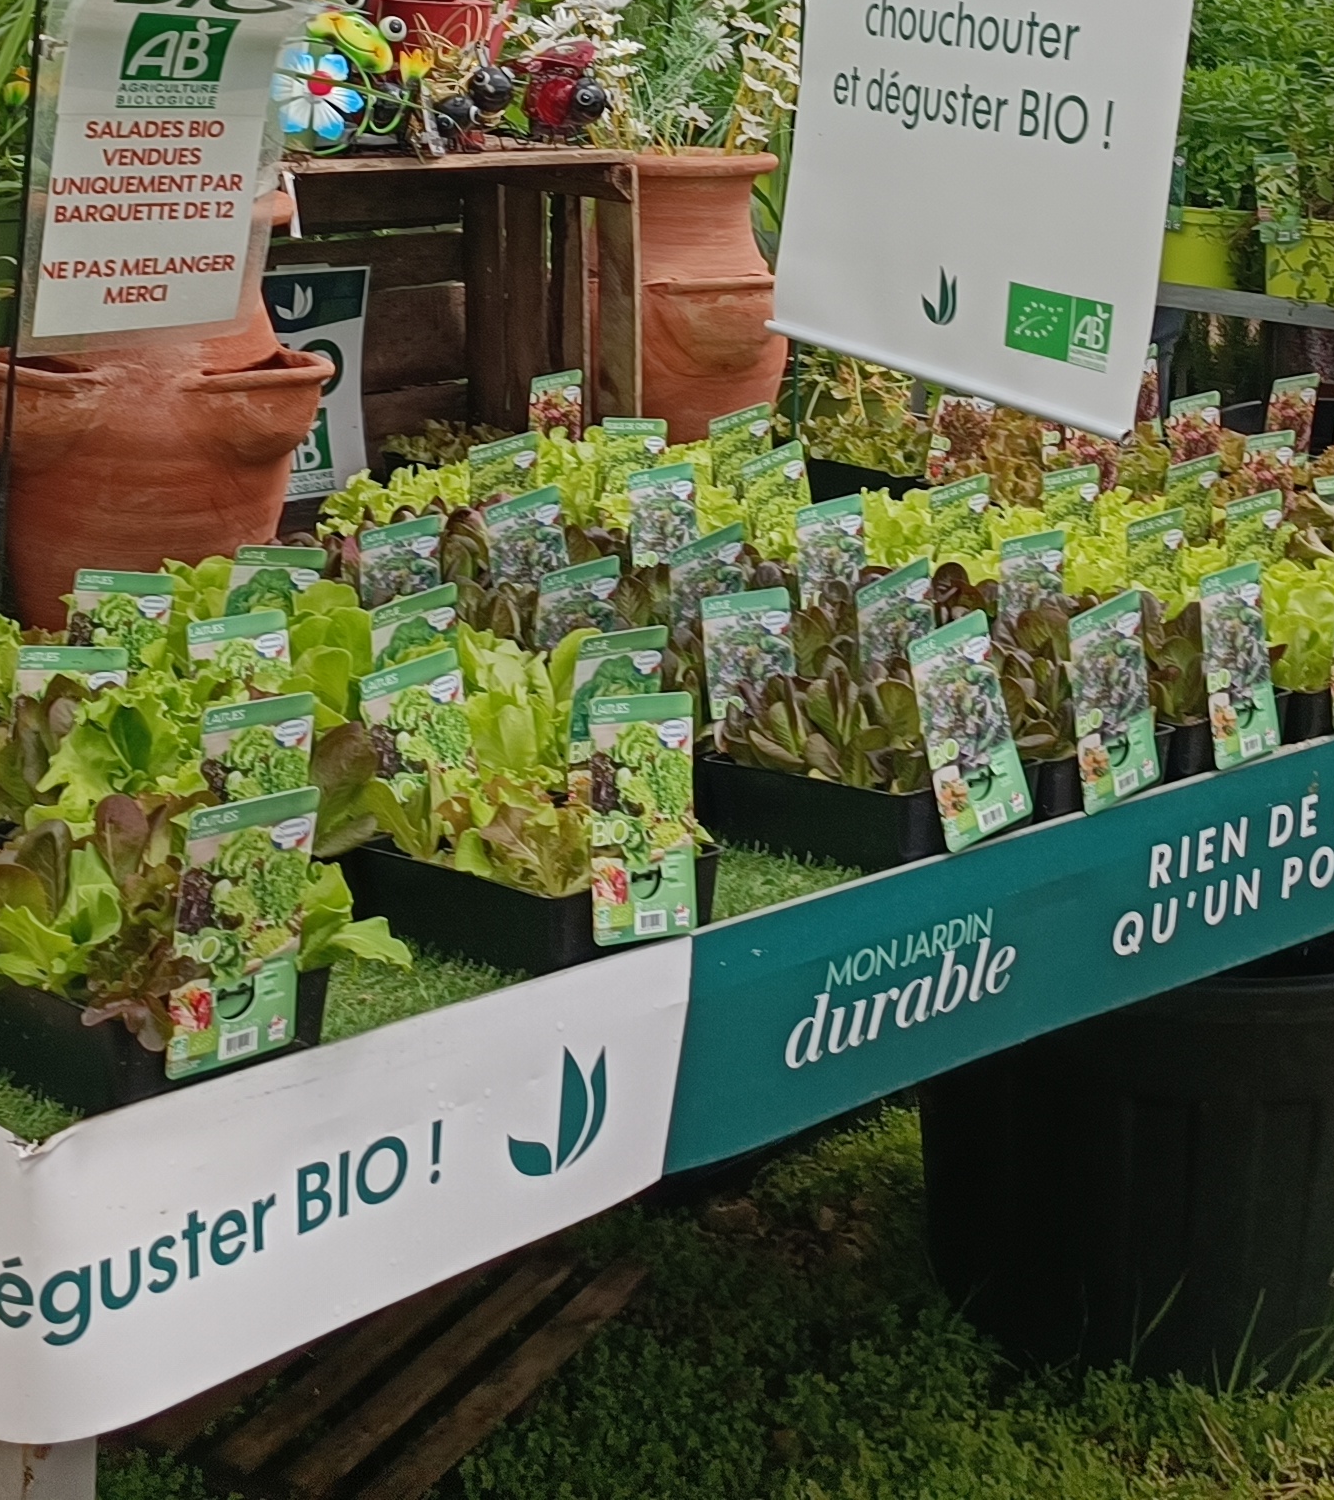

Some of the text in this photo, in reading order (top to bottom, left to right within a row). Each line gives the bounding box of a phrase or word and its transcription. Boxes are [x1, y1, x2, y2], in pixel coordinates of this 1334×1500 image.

[126, 30, 209, 79] AB
[116, 95, 217, 106] BIOLOGIQUE
[118, 83, 219, 94] AGRICULTURE
[834, 66, 861, 107] et
[867, 68, 1009, 132] déguster
[1019, 88, 1089, 145] BIO
[85, 120, 225, 139] SALADES BIO
[102, 147, 202, 167] VENDUES
[52, 174, 243, 195] UNIQUEMENT PAR
[54, 200, 235, 223] BARQUETTE DE 12
[42, 254, 236, 279] NE PAS MELANGER
[103, 284, 168, 305] MERCI
[592, 819, 630, 847] BIO
[1149, 816, 1248, 888] RIEN
[1268, 794, 1319, 848] DE
[825, 907, 994, 992] MON JARDIN
[784, 937, 1017, 1069] durable
[296, 1136, 408, 1235] BIO
